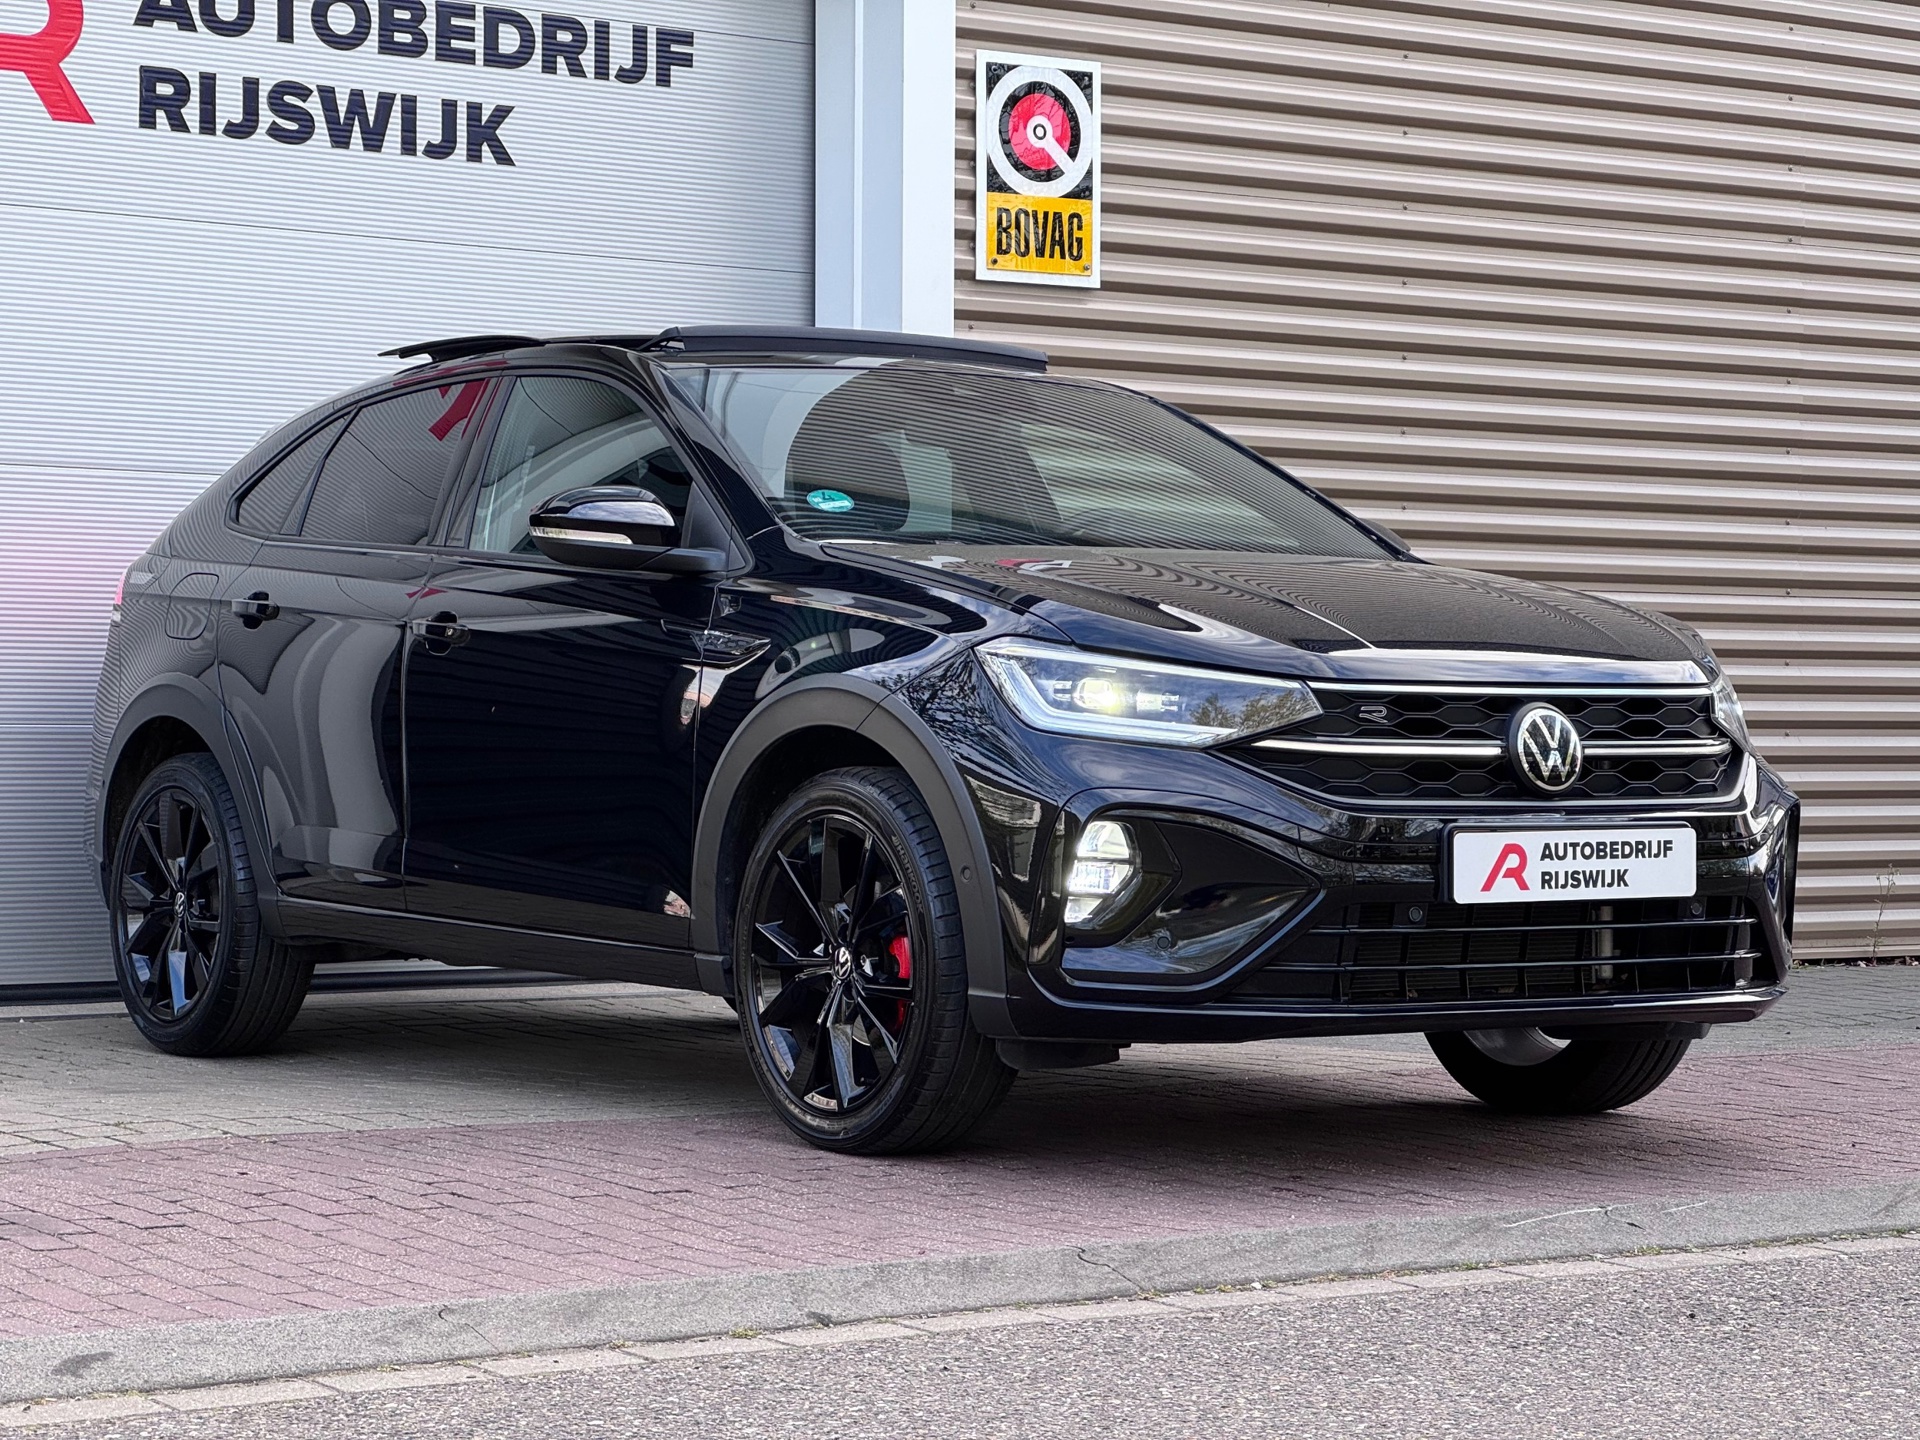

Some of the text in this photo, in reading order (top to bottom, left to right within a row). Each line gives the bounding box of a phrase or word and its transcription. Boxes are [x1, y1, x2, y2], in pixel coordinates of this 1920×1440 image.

[138, 66, 516, 167] RIJSWIJK
[996, 207, 1084, 262] BOVAG
[1540, 840, 1674, 861] AUTOBEDRIJF
[1541, 869, 1630, 890] RIJSWIJK
